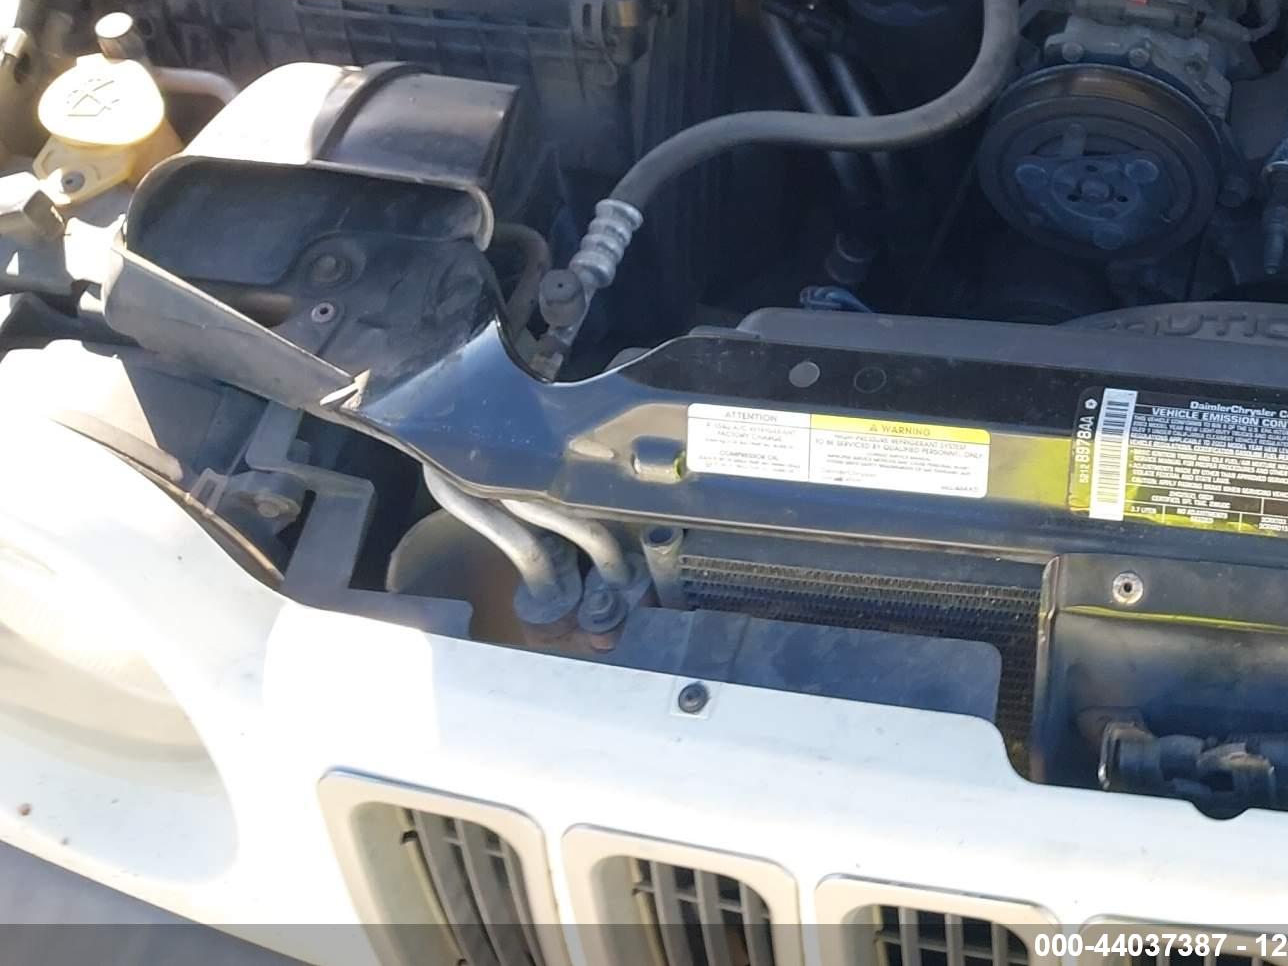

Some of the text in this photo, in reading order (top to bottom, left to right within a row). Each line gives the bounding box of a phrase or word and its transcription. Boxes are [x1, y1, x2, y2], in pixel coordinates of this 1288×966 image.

[724, 410, 777, 422] ATTENTION
[1151, 407, 1198, 419] VEHICLE
[1201, 412, 1258, 425] EMISSION
[1189, 400, 1276, 417] DaimlerChrysler
[880, 424, 928, 436] WARNING
[1075, 416, 1095, 462] 8978AA
